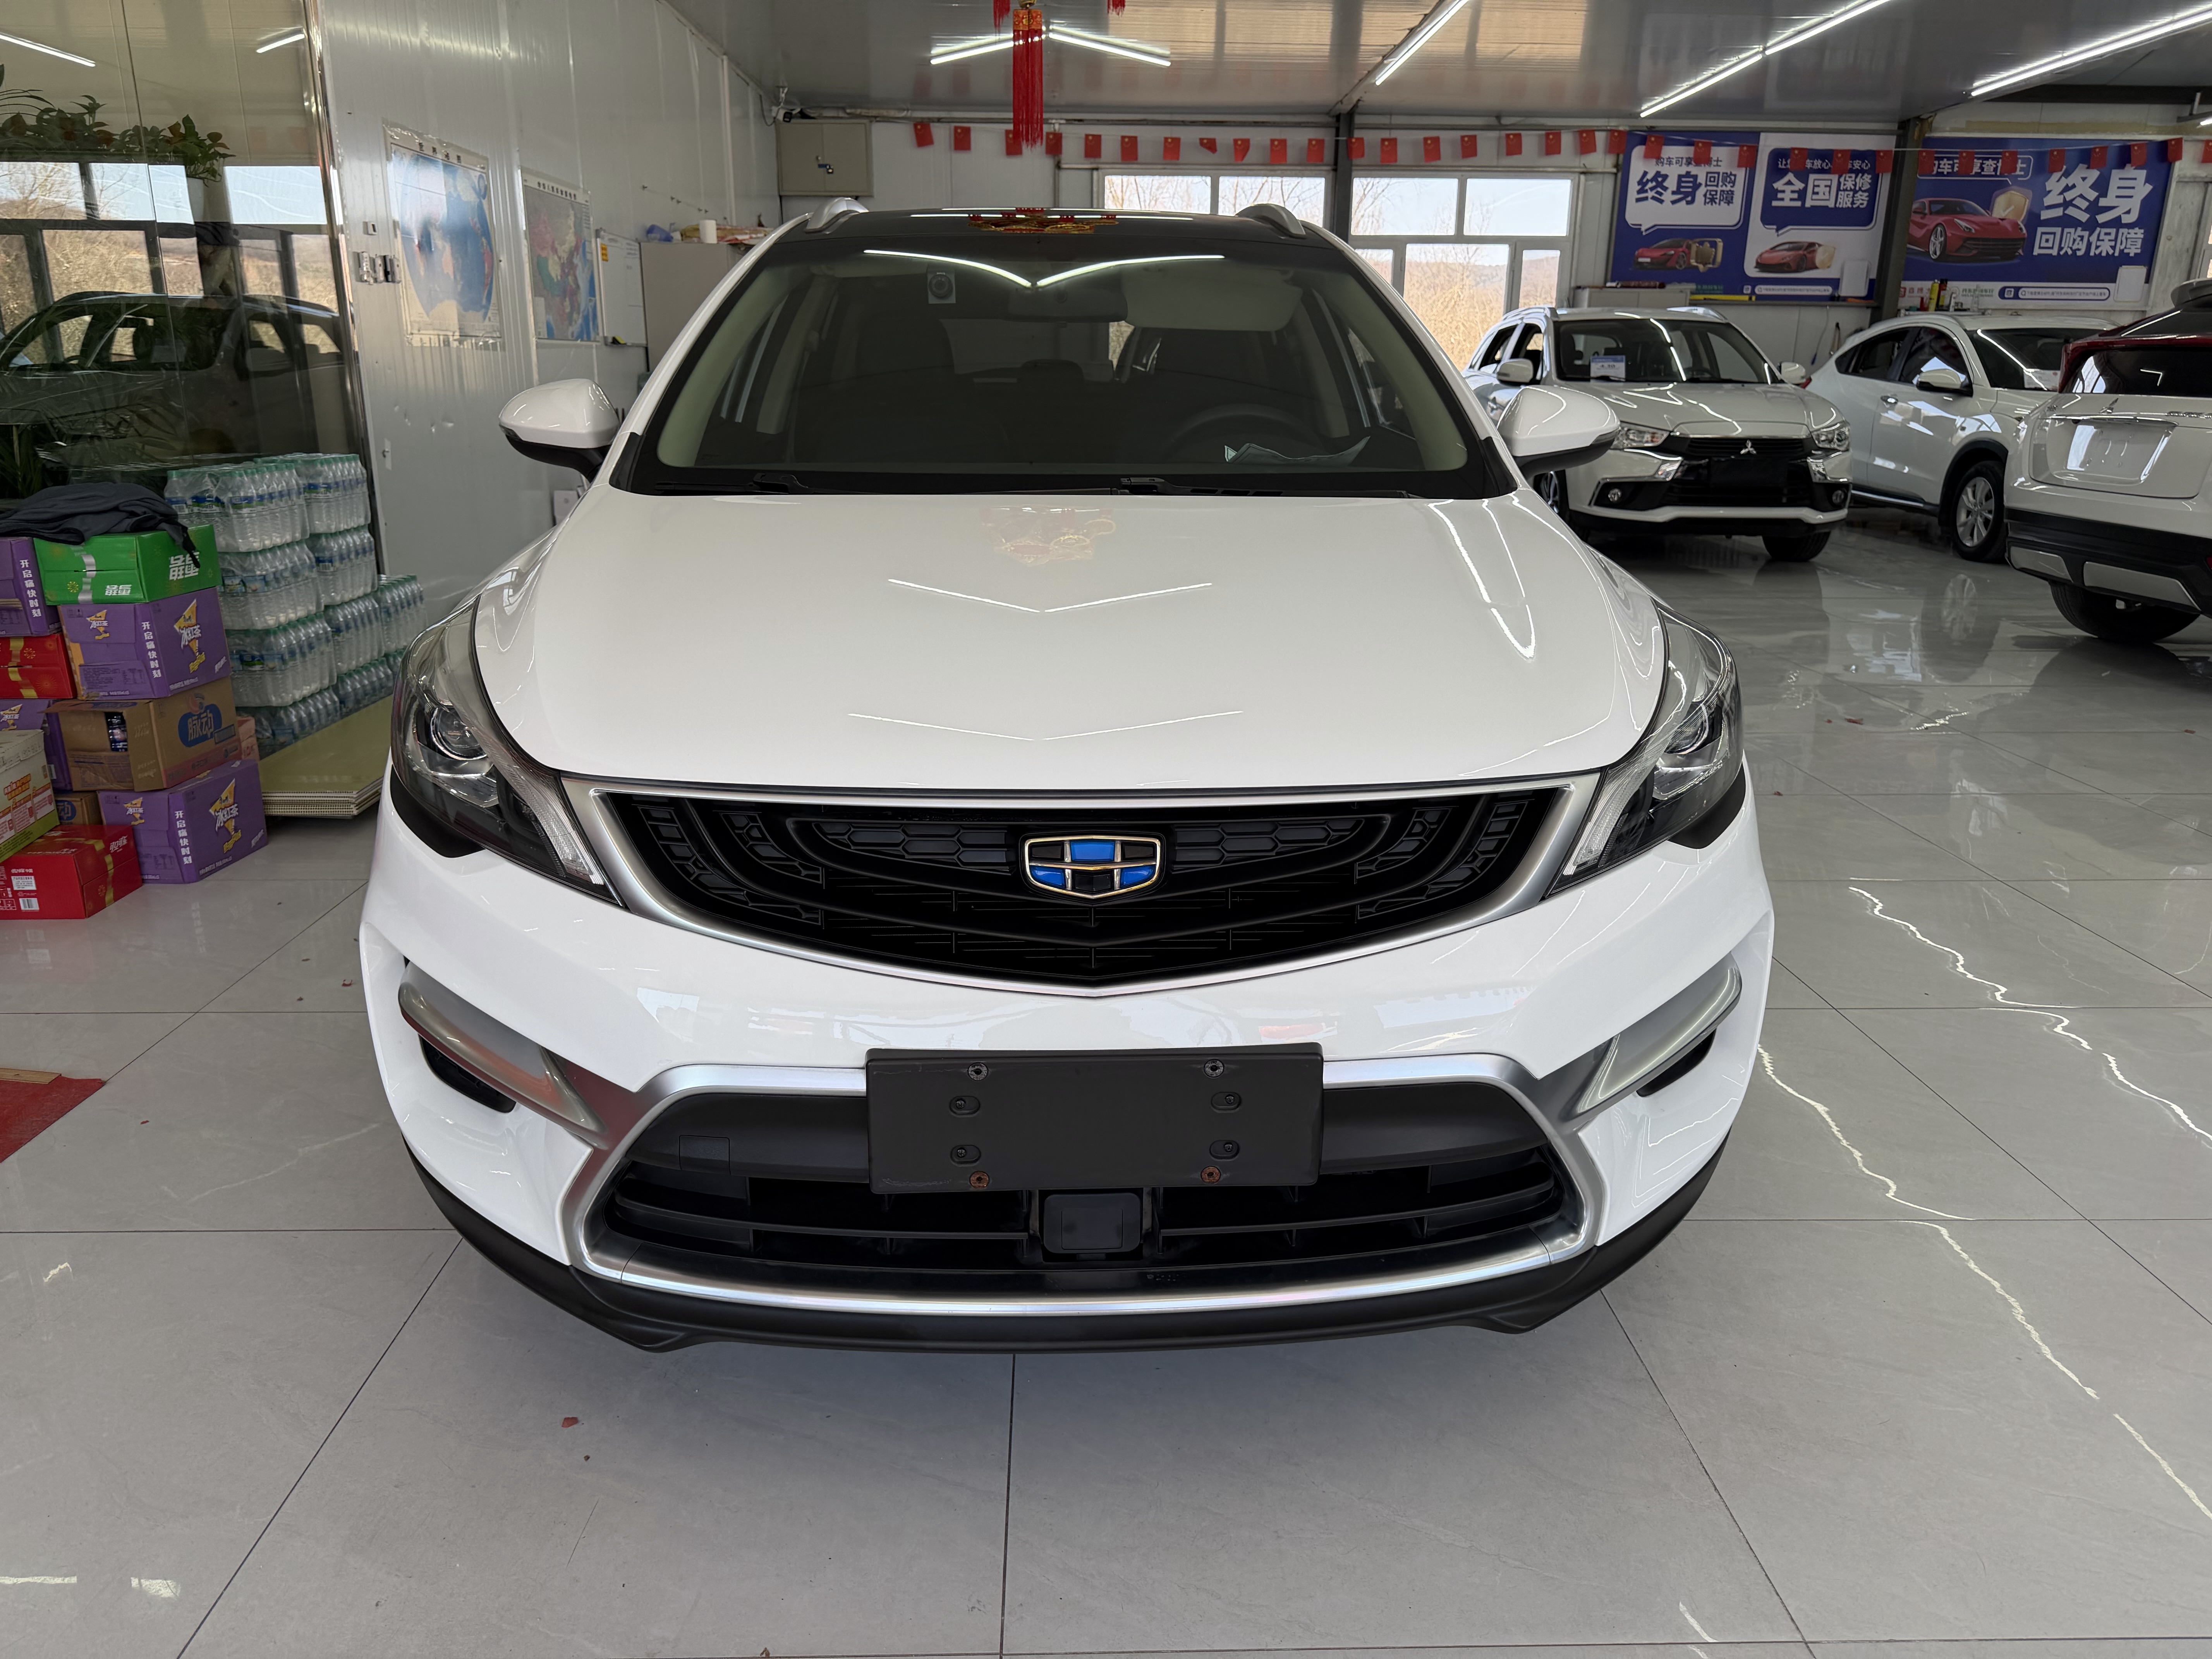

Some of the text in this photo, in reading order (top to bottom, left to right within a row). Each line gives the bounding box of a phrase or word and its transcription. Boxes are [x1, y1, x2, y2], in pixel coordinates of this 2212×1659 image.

[1655, 156, 1723, 167] 购车可享士
[1635, 170, 1703, 205] 终身
[1705, 171, 1737, 188] 回购
[1771, 172, 1839, 208] 全国
[1839, 173, 1872, 191] 保修
[2040, 163, 2153, 224] 终身
[1703, 189, 1735, 206] 保障
[1836, 191, 1869, 208] 服务
[2033, 227, 2144, 257] 回购保障
[20, 560, 41, 617] 开启痛快时刻
[105, 585, 132, 596] 雪碧
[141, 621, 161, 678] 开启痛快时刻
[179, 624, 201, 649] 冰红茶
[187, 709, 214, 742] 脉动
[215, 803, 239, 832] 冰红茶
[175, 810, 192, 864] 开启痛快时刻
